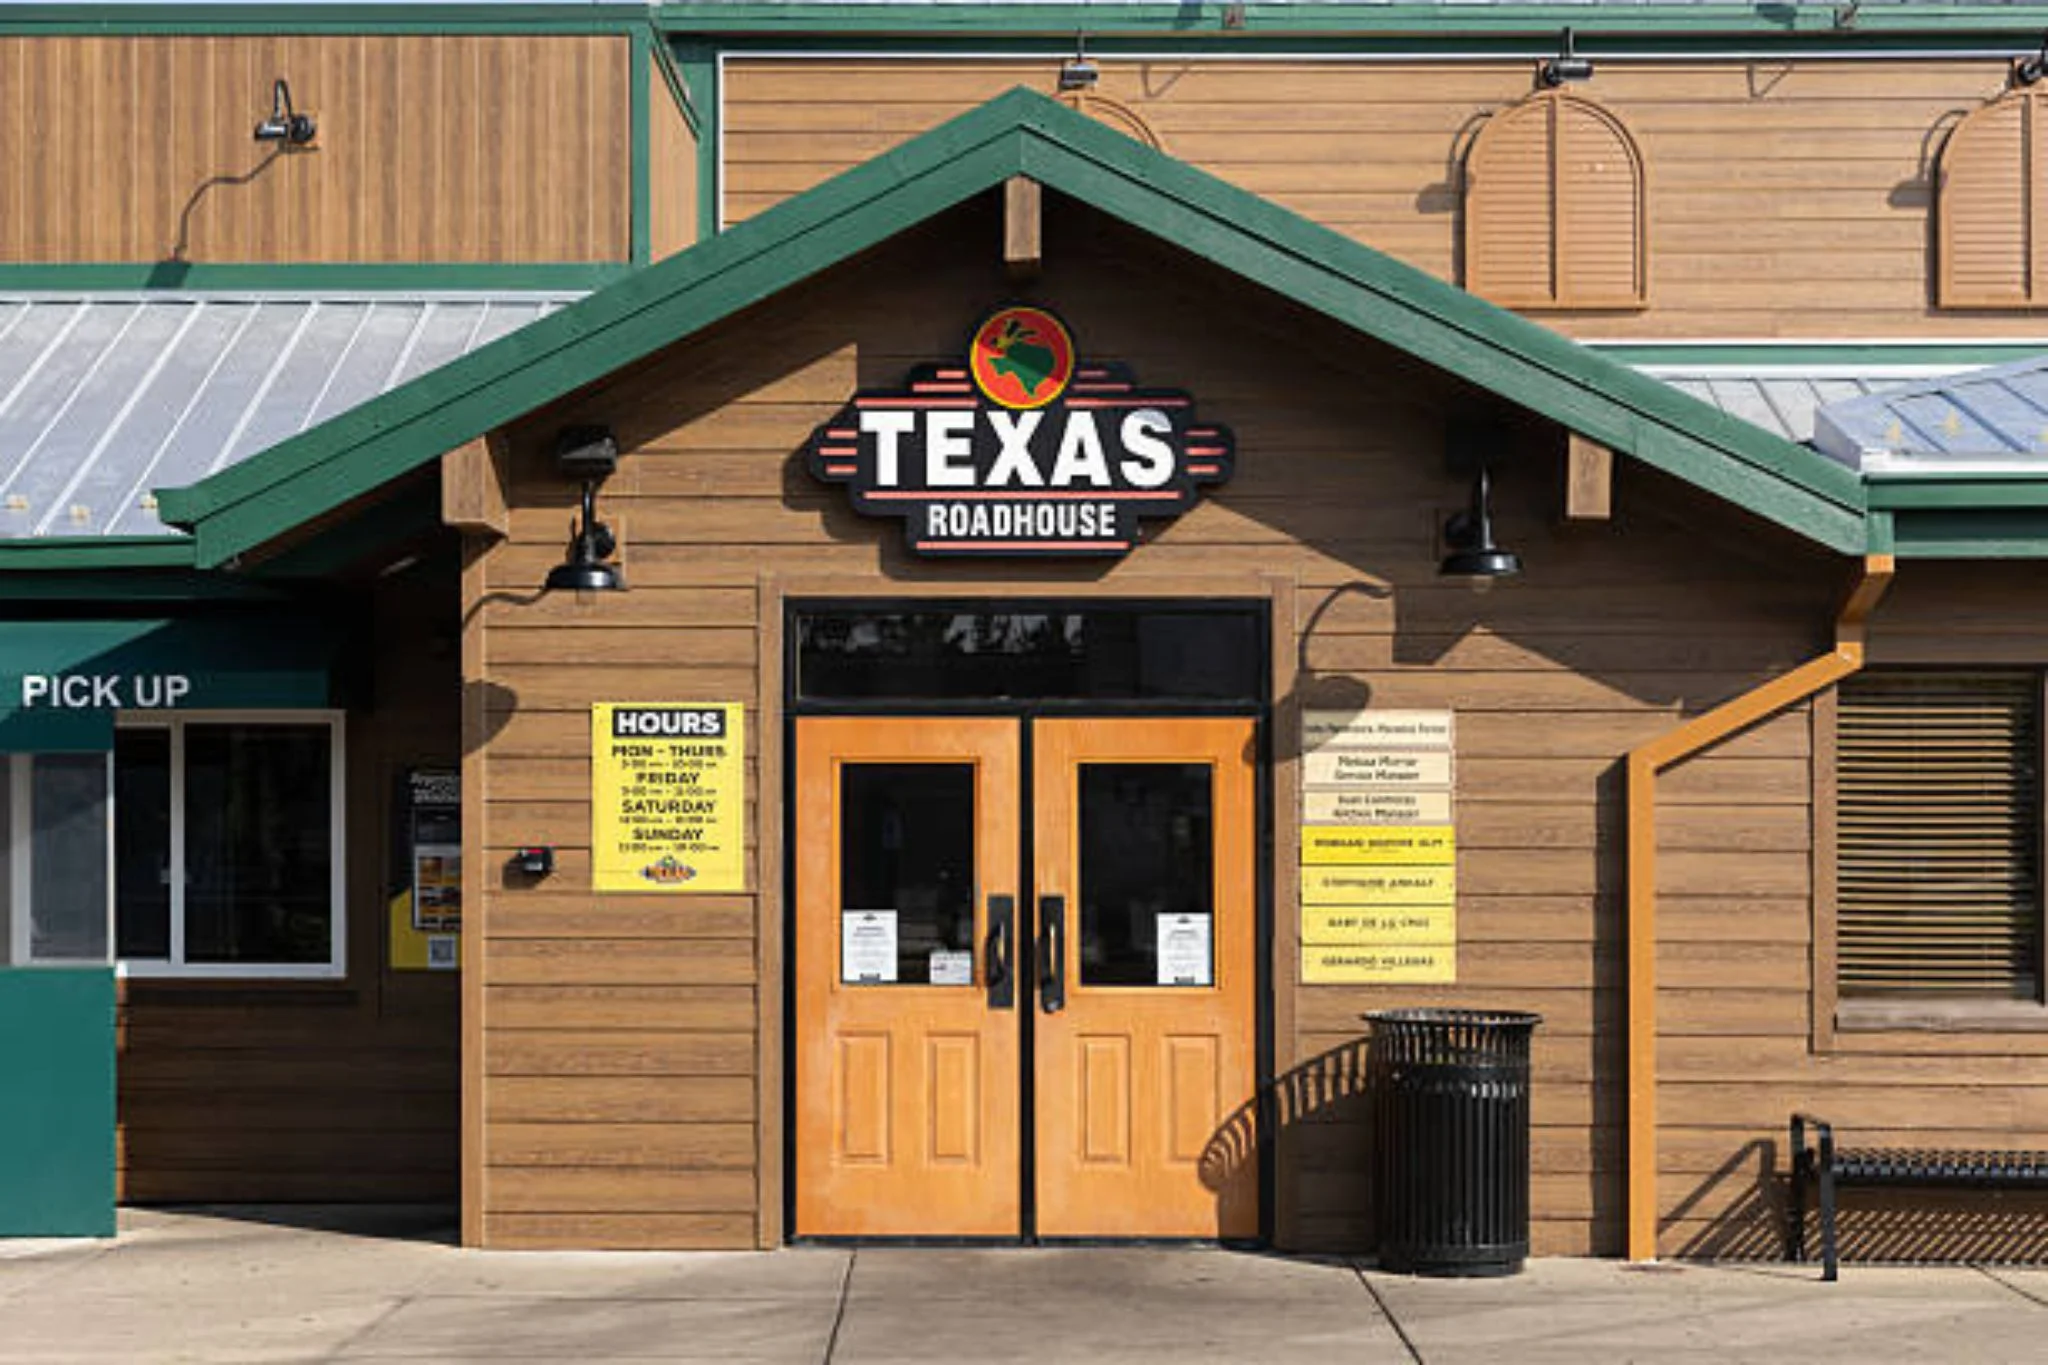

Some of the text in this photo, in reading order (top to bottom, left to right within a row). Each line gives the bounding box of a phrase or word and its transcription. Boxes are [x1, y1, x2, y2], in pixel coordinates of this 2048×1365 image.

[860, 408, 1176, 489] TEXAS
[927, 504, 1116, 537] ROADHOUSE
[22, 675, 190, 707] PICK UP
[617, 711, 721, 734] HOURS
[611, 745, 654, 757] MON
[635, 771, 700, 784] FRIDAY
[621, 799, 716, 814] SATURDAY
[632, 828, 704, 840] SUNDAY
